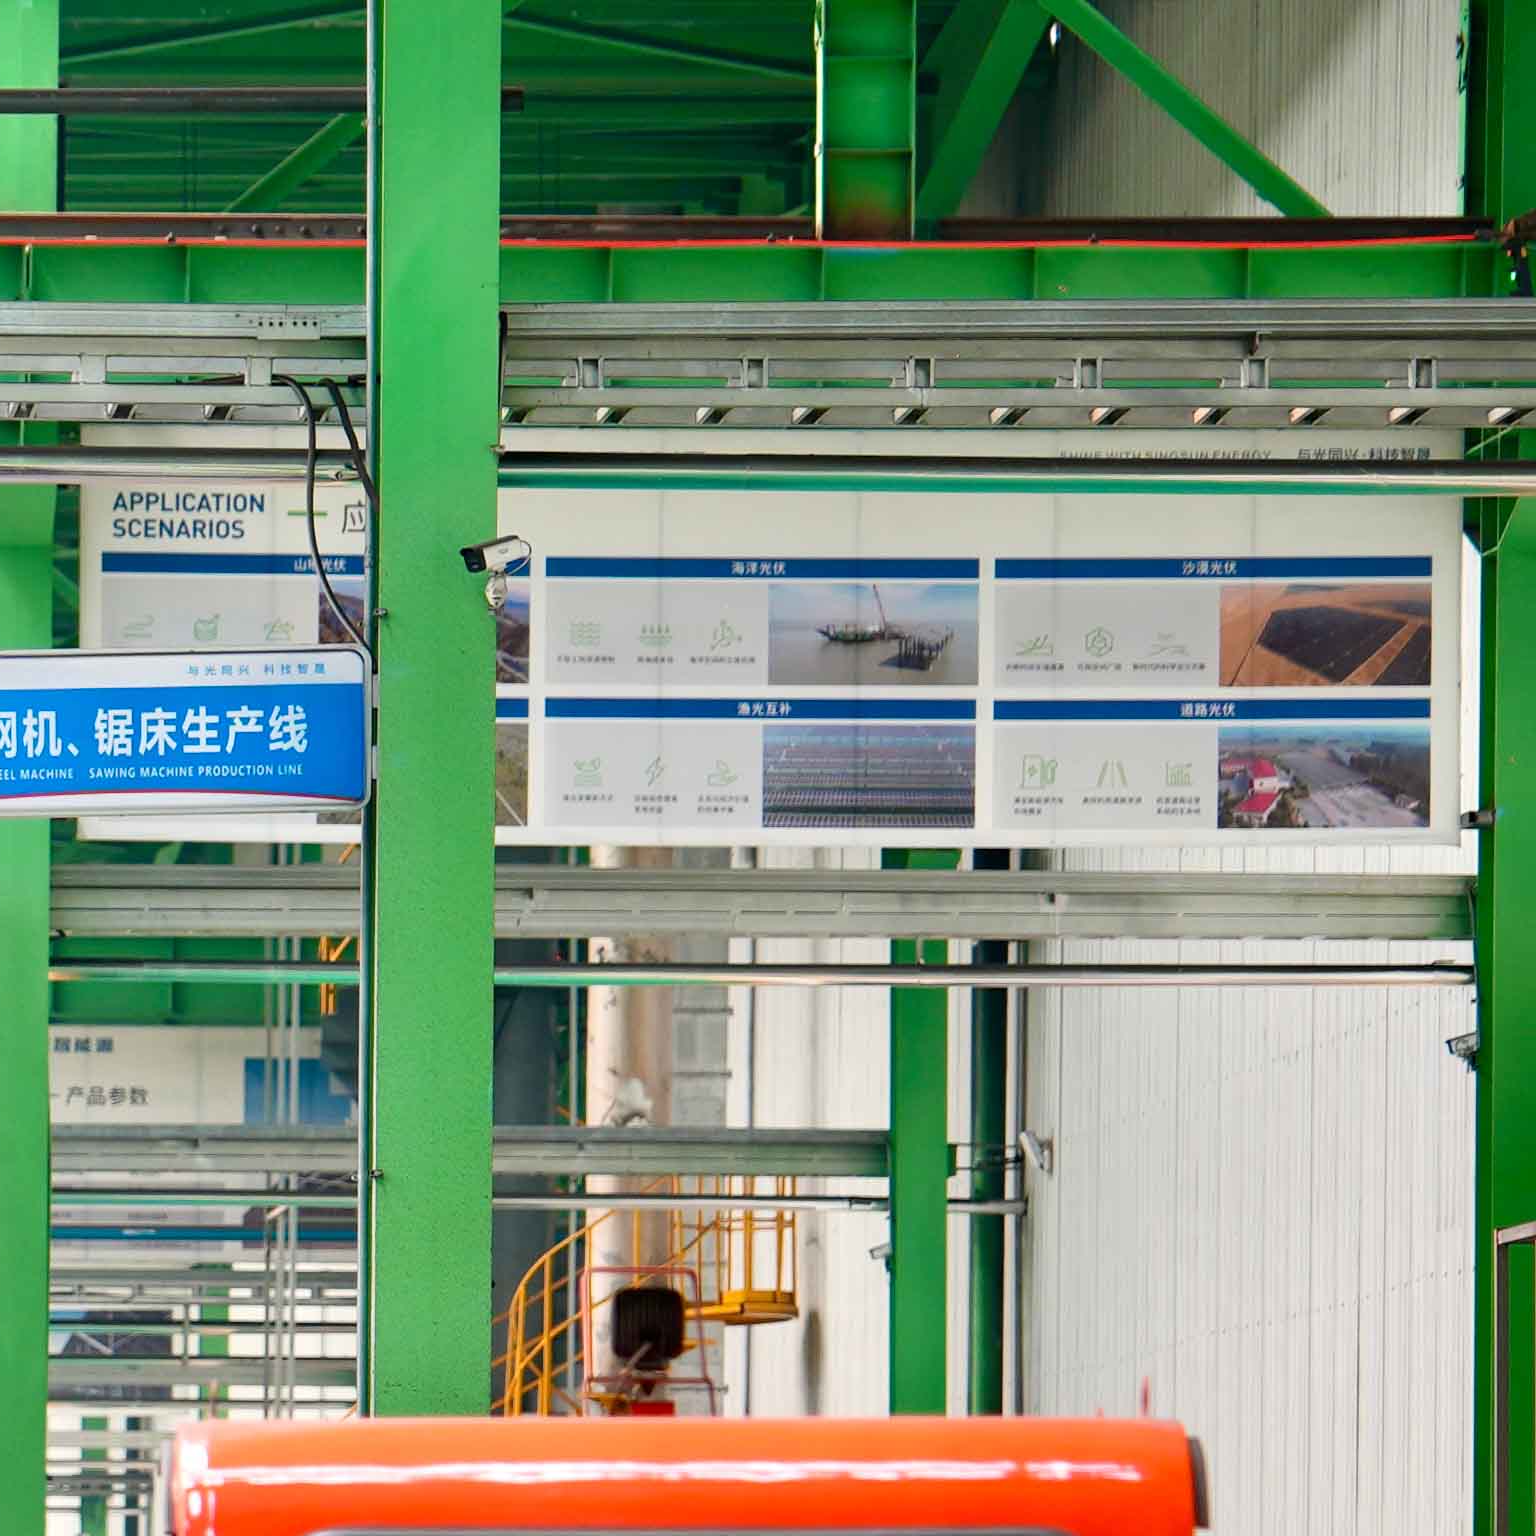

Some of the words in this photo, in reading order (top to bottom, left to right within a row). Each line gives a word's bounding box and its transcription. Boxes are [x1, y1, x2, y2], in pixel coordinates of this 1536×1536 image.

[112, 492, 265, 513] APPLICATION
[112, 518, 245, 539] SCENARIOS
[731, 560, 787, 576] 海洋光伏
[1181, 560, 1238, 576] 沙漠光伏
[736, 702, 792, 717] 渔光互补
[1180, 702, 1236, 718] 道路光伏
[19, 768, 74, 781] MACHINE
[88, 767, 136, 780] SAWING
[139, 766, 194, 779] MACHINE
[198, 765, 275, 778] PRODUCTION
[277, 764, 304, 777] LINE
[65, 1085, 149, 1106] 产品参数
